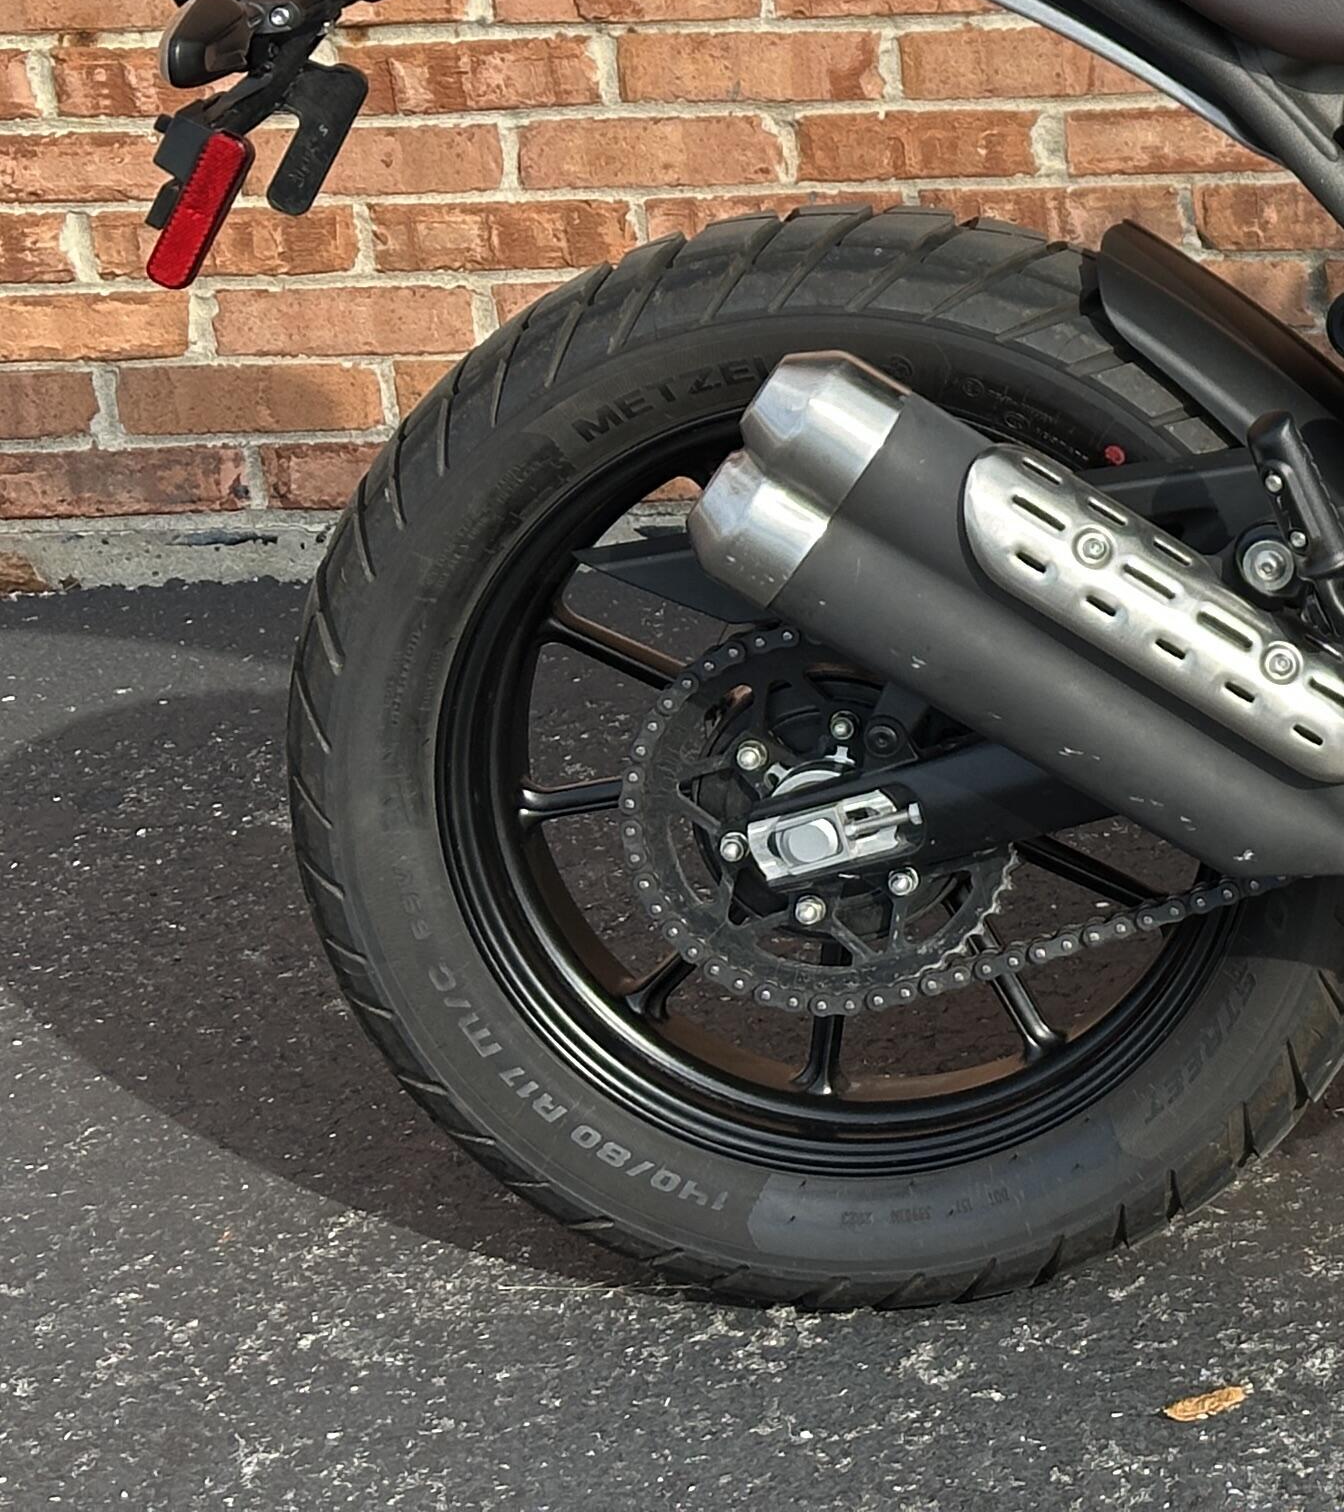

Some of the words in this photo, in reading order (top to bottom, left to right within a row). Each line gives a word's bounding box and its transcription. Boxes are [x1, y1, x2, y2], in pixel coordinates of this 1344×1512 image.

[427, 961, 503, 1058] M/C
[499, 1066, 568, 1123] R17
[570, 1124, 729, 1212] 140/80
